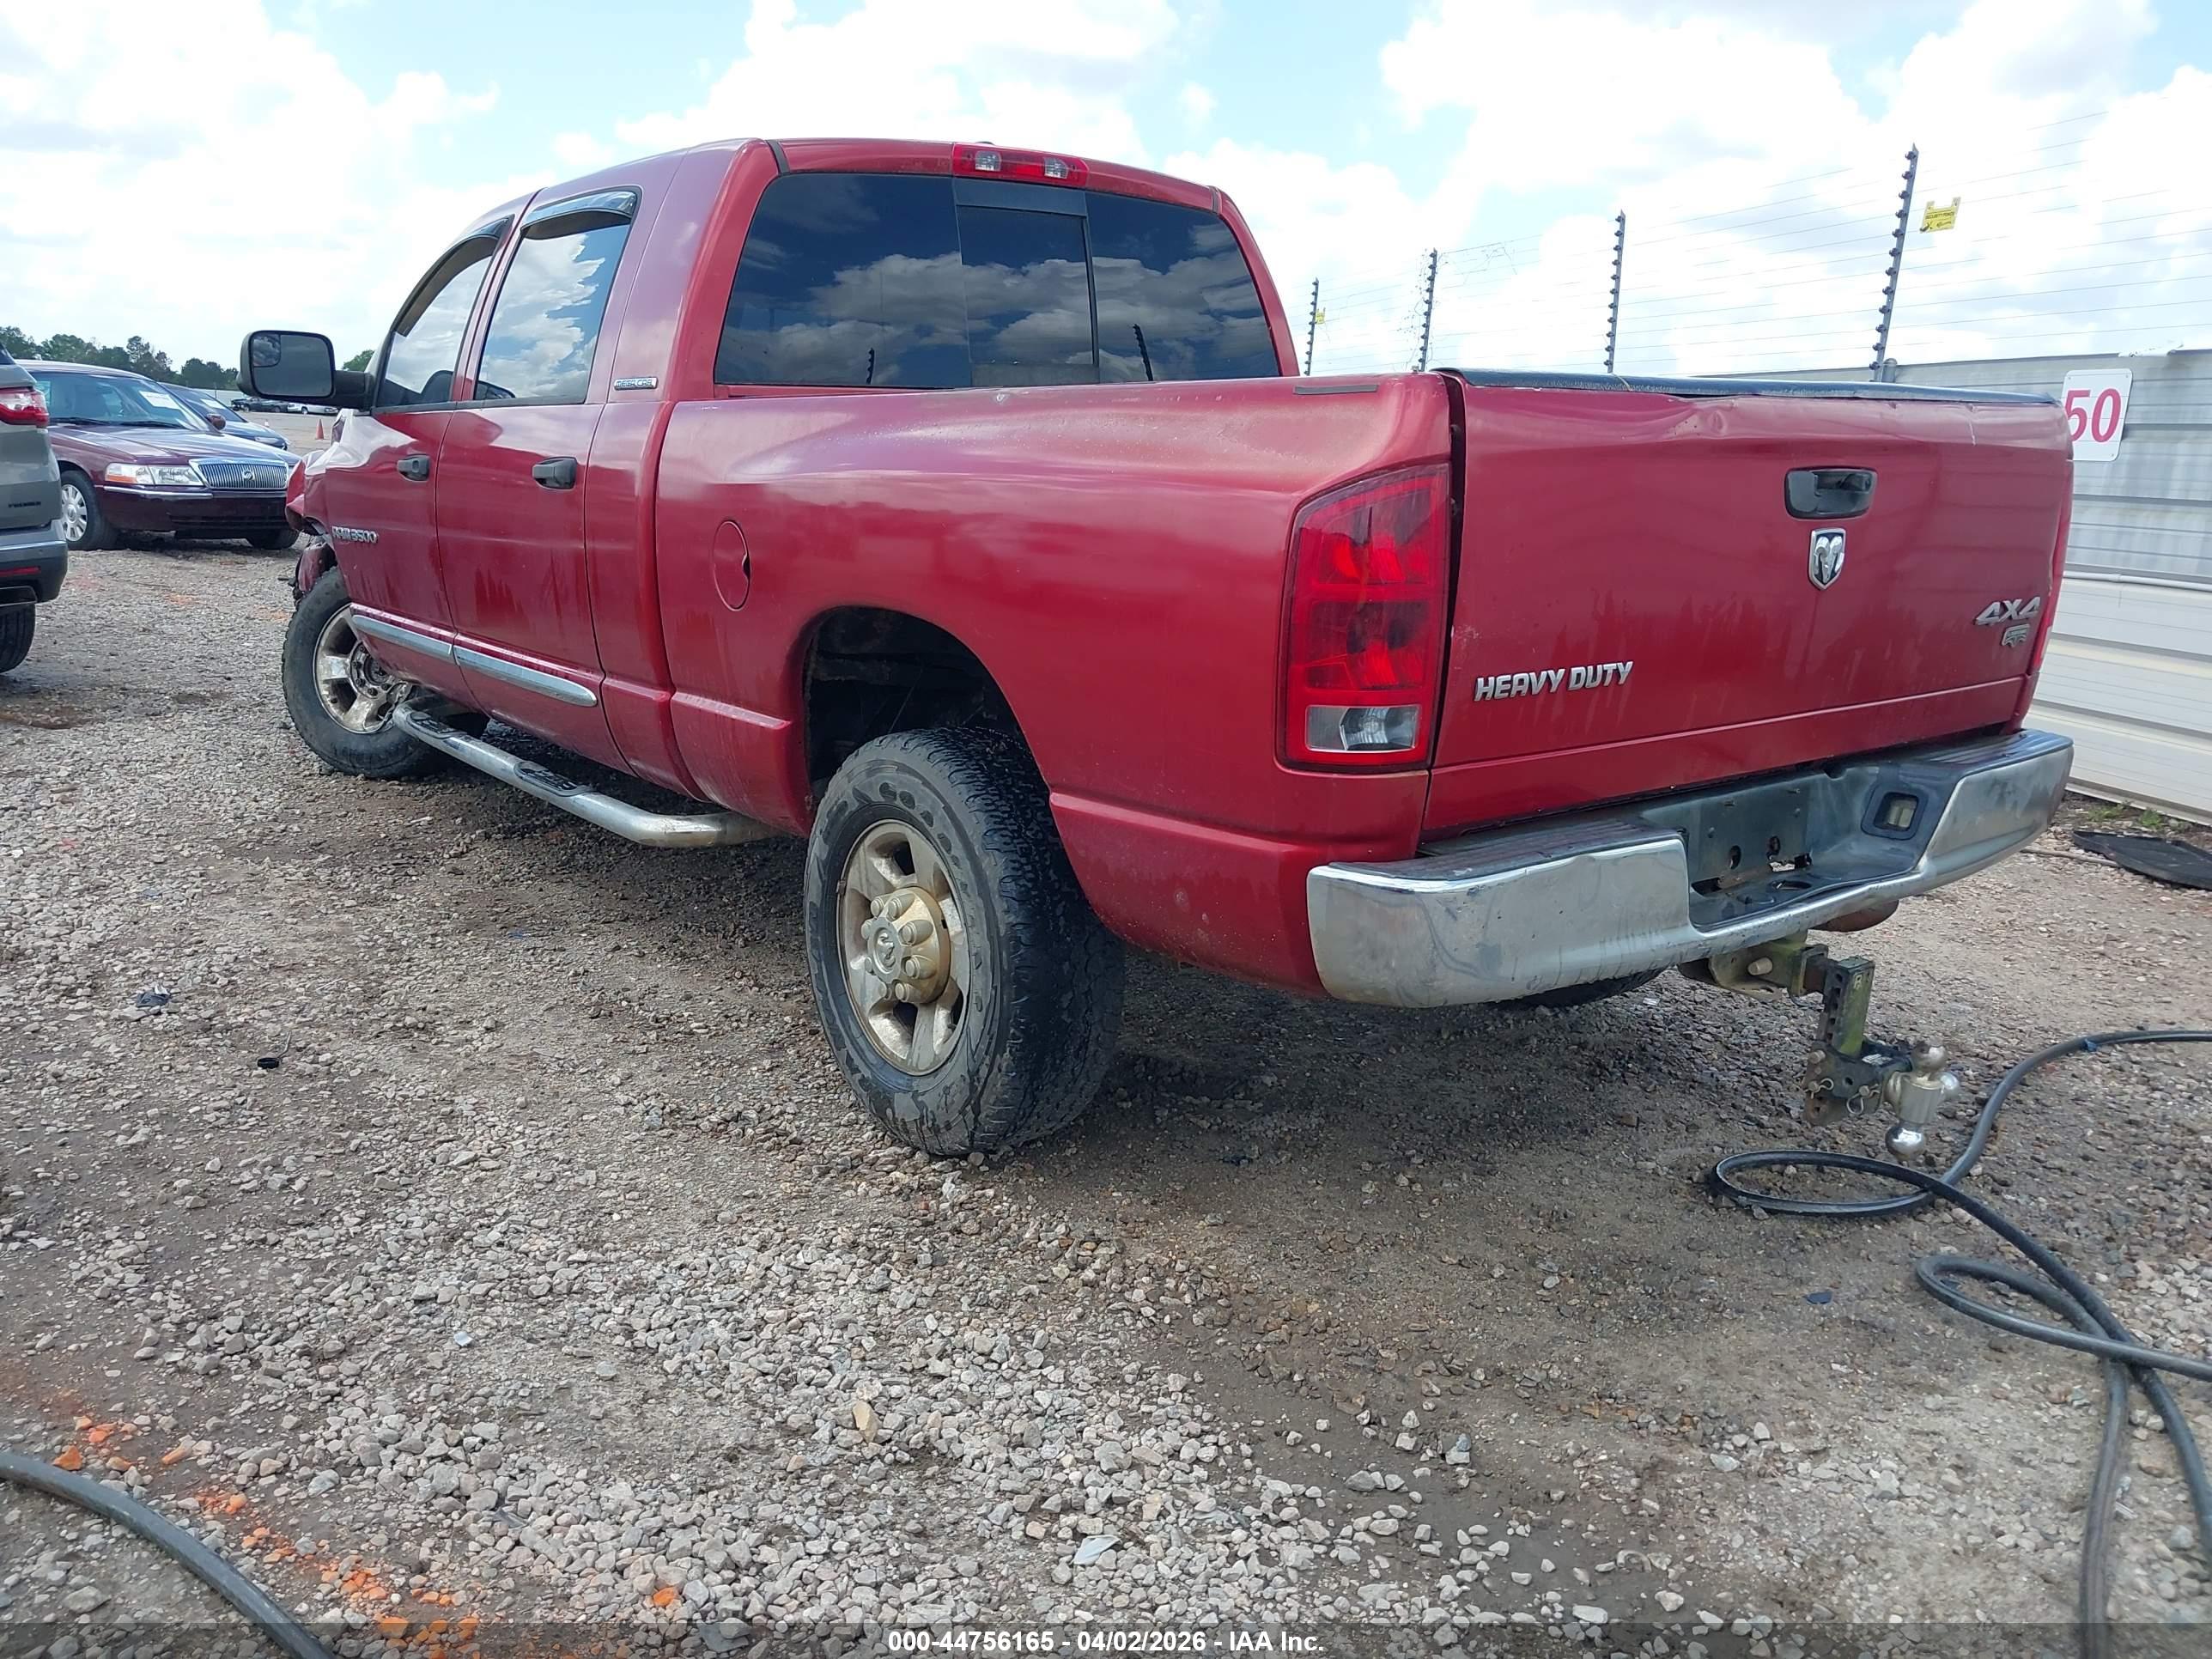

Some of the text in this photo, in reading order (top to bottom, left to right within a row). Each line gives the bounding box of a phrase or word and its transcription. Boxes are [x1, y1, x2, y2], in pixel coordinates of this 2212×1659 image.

[2065, 388, 2122, 443] 50
[1474, 660, 1633, 702] HEAVY DUTY
